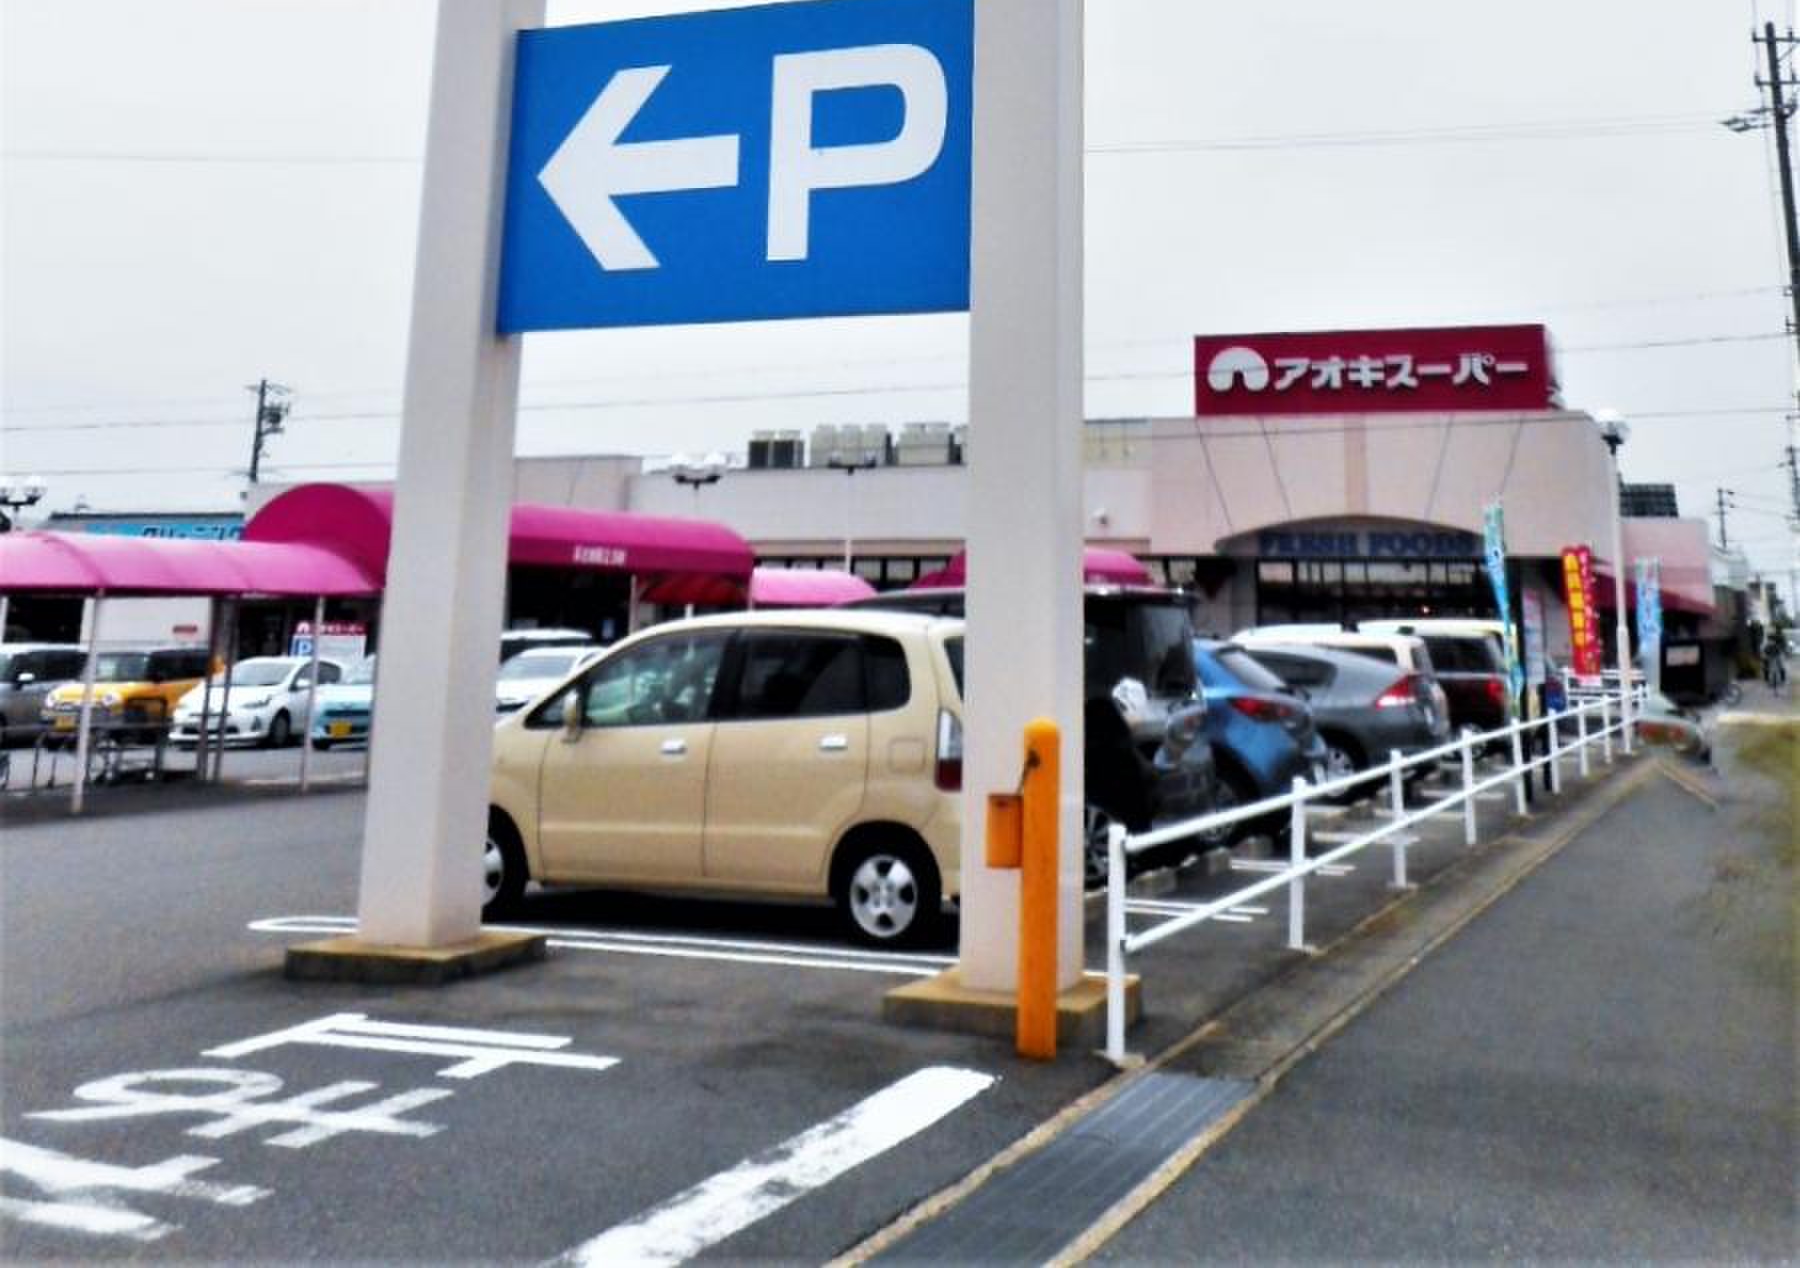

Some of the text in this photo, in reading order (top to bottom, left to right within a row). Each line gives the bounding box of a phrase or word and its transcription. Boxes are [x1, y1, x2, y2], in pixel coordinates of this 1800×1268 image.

[767, 43, 948, 261] P
[1274, 354, 1528, 391] アオキスーパー
